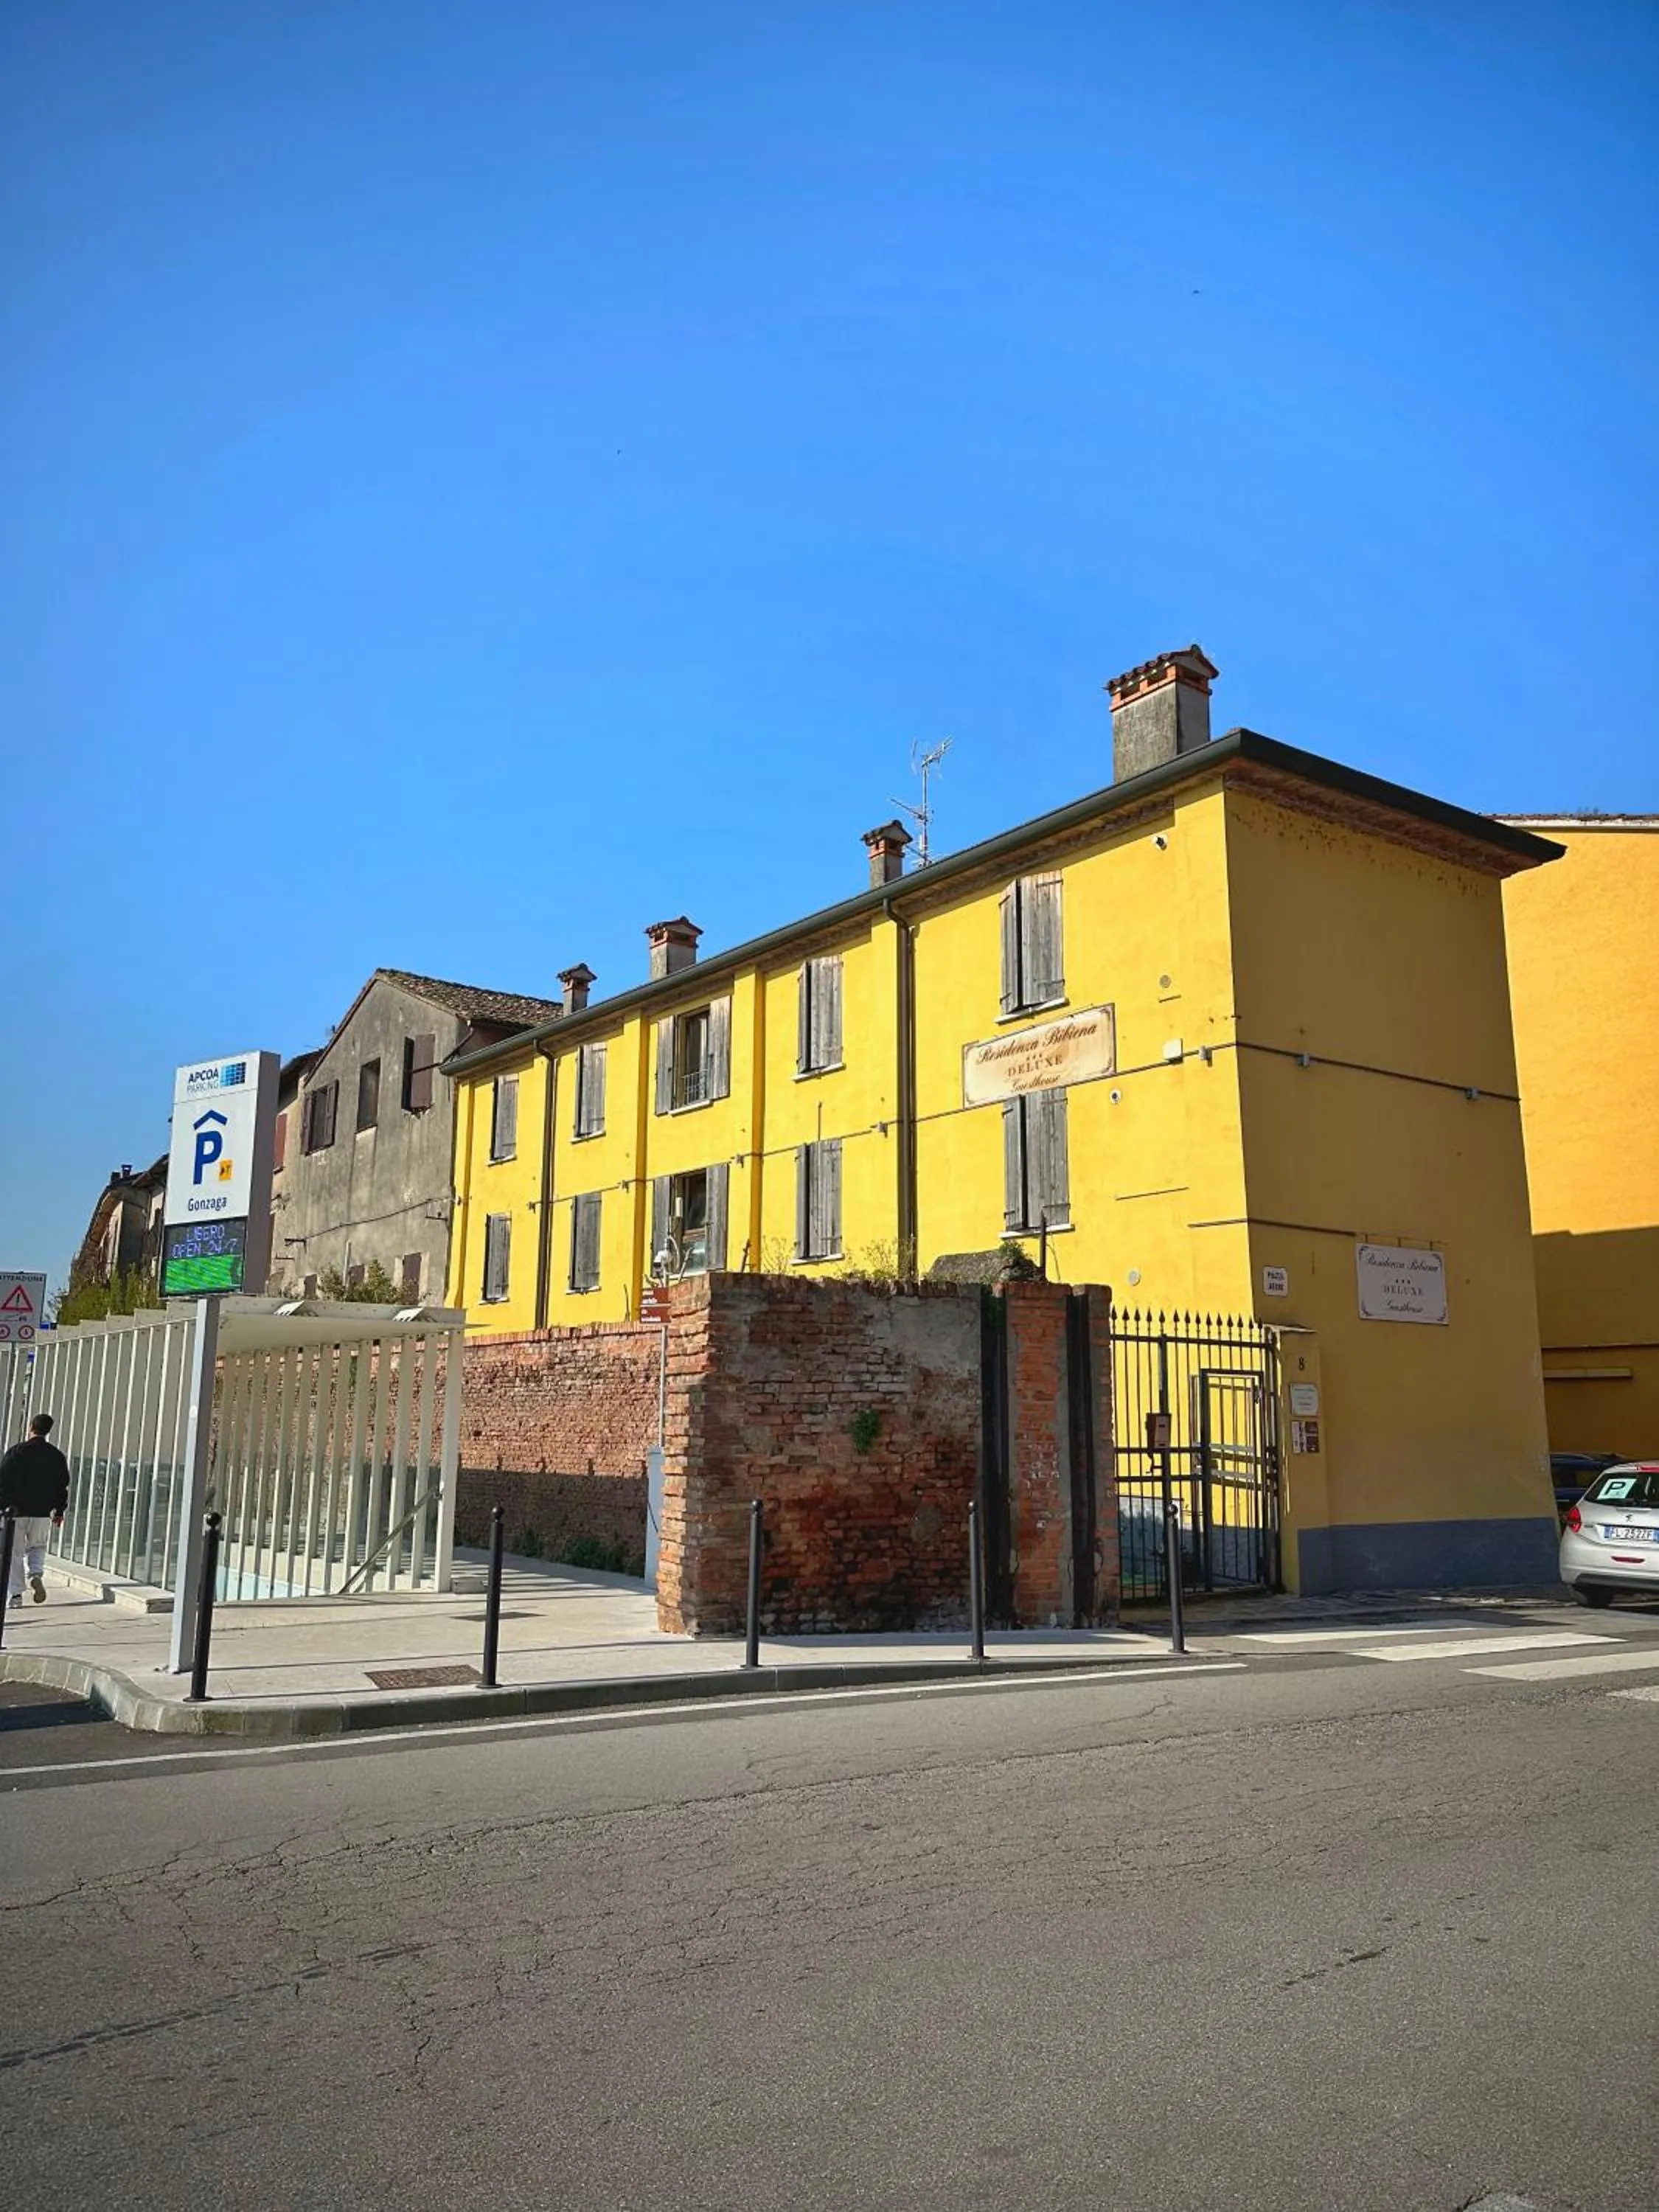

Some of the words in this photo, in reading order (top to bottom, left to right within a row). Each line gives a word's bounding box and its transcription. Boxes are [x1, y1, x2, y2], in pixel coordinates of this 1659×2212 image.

[976, 1040, 1039, 1064] Residenza
[1042, 1023, 1098, 1047] Bibiena
[1007, 1054, 1062, 1077] DELUXE
[189, 1068, 219, 1083] APCOA
[1011, 1074, 1060, 1092] Guesthouse
[187, 1079, 219, 1092] PARKING
[193, 1131, 223, 1185] P
[188, 1197, 227, 1211] Gonzaga
[187, 1225, 225, 1242] LIBERO
[173, 1241, 201, 1258] OPEN
[209, 1238, 237, 1255] 24/7
[1383, 1285, 1423, 1295] DELUXE
[1298, 1356, 1305, 1371] 8
[1604, 1481, 1626, 1495] P
